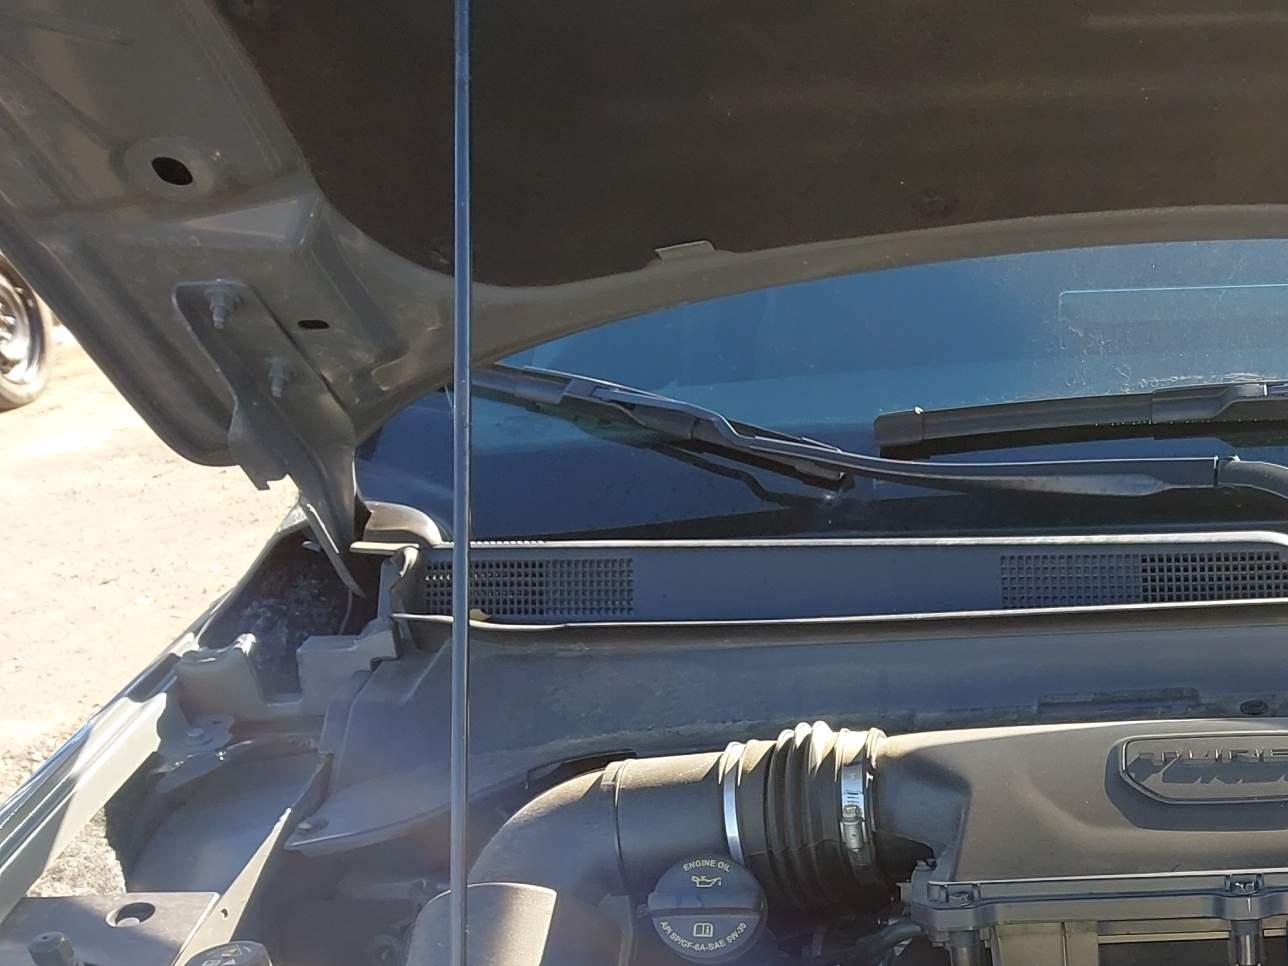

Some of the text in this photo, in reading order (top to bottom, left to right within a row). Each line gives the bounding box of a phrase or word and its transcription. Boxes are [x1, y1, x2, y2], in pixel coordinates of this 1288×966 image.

[683, 859, 731, 873] ENGINE OIL
[660, 921, 673, 935] API
